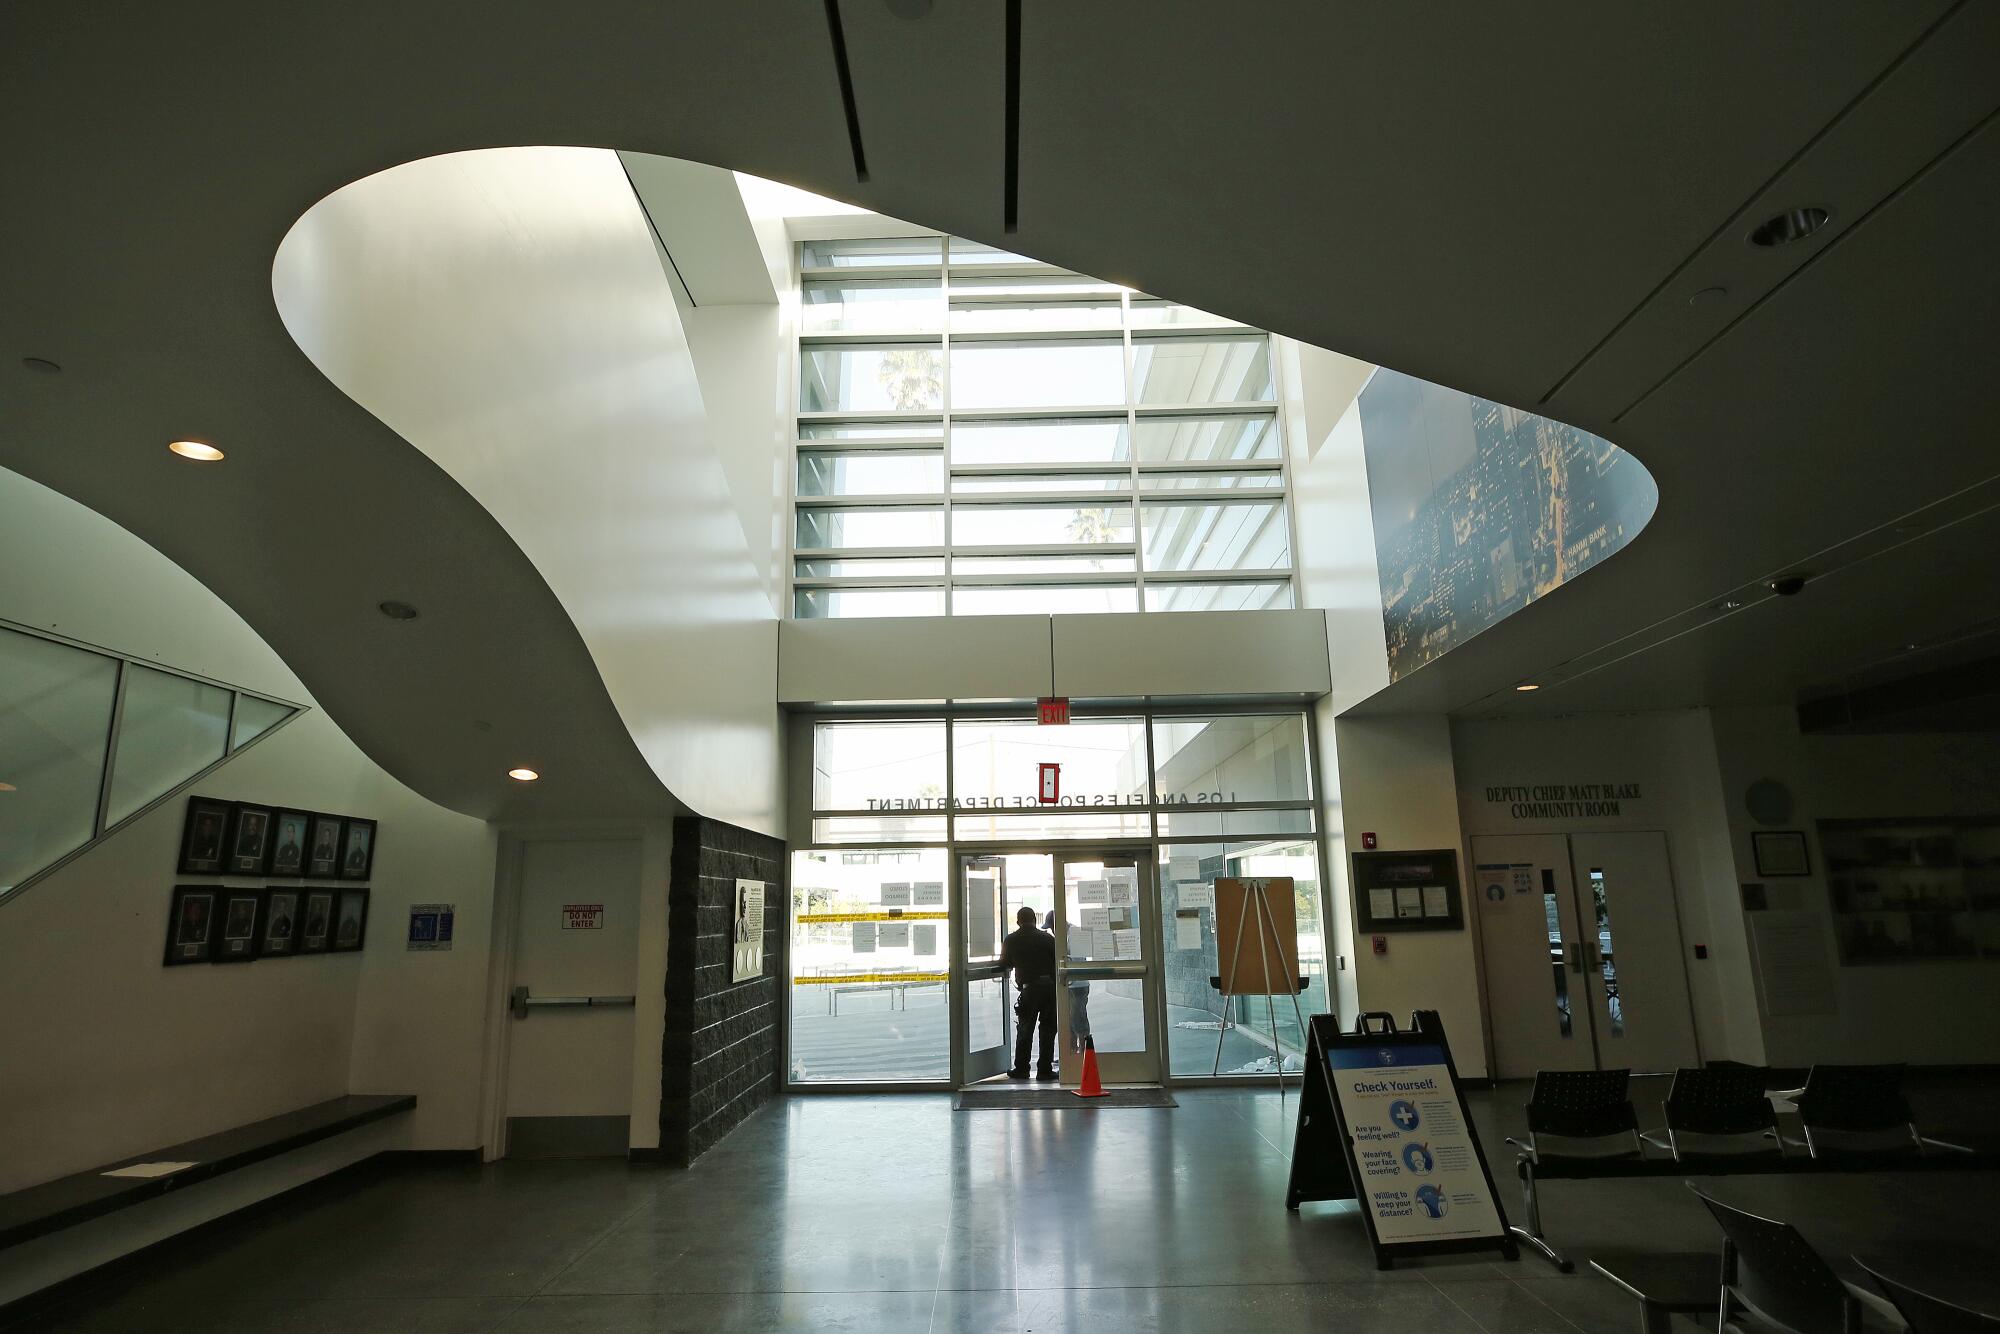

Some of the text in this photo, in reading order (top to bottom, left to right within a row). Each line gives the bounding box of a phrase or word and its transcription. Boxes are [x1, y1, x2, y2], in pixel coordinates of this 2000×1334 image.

[1589, 523, 1607, 544] BANK
[1042, 704, 1067, 723] EXIT
[1486, 783, 1642, 802] DEPUTY CHIEF MATT BLAKE
[1511, 801, 1620, 819] COMMUNITY ROOM
[1354, 1079, 1437, 1093] Check Yourself.
[1357, 1131, 1400, 1141] feeling well?
[1362, 1151, 1392, 1159] Wearing
[1367, 1167, 1401, 1175] covering?
[1373, 1192, 1400, 1200] Willing
[1376, 1201, 1411, 1209] keep your
[1380, 1208, 1413, 1217] distance?
